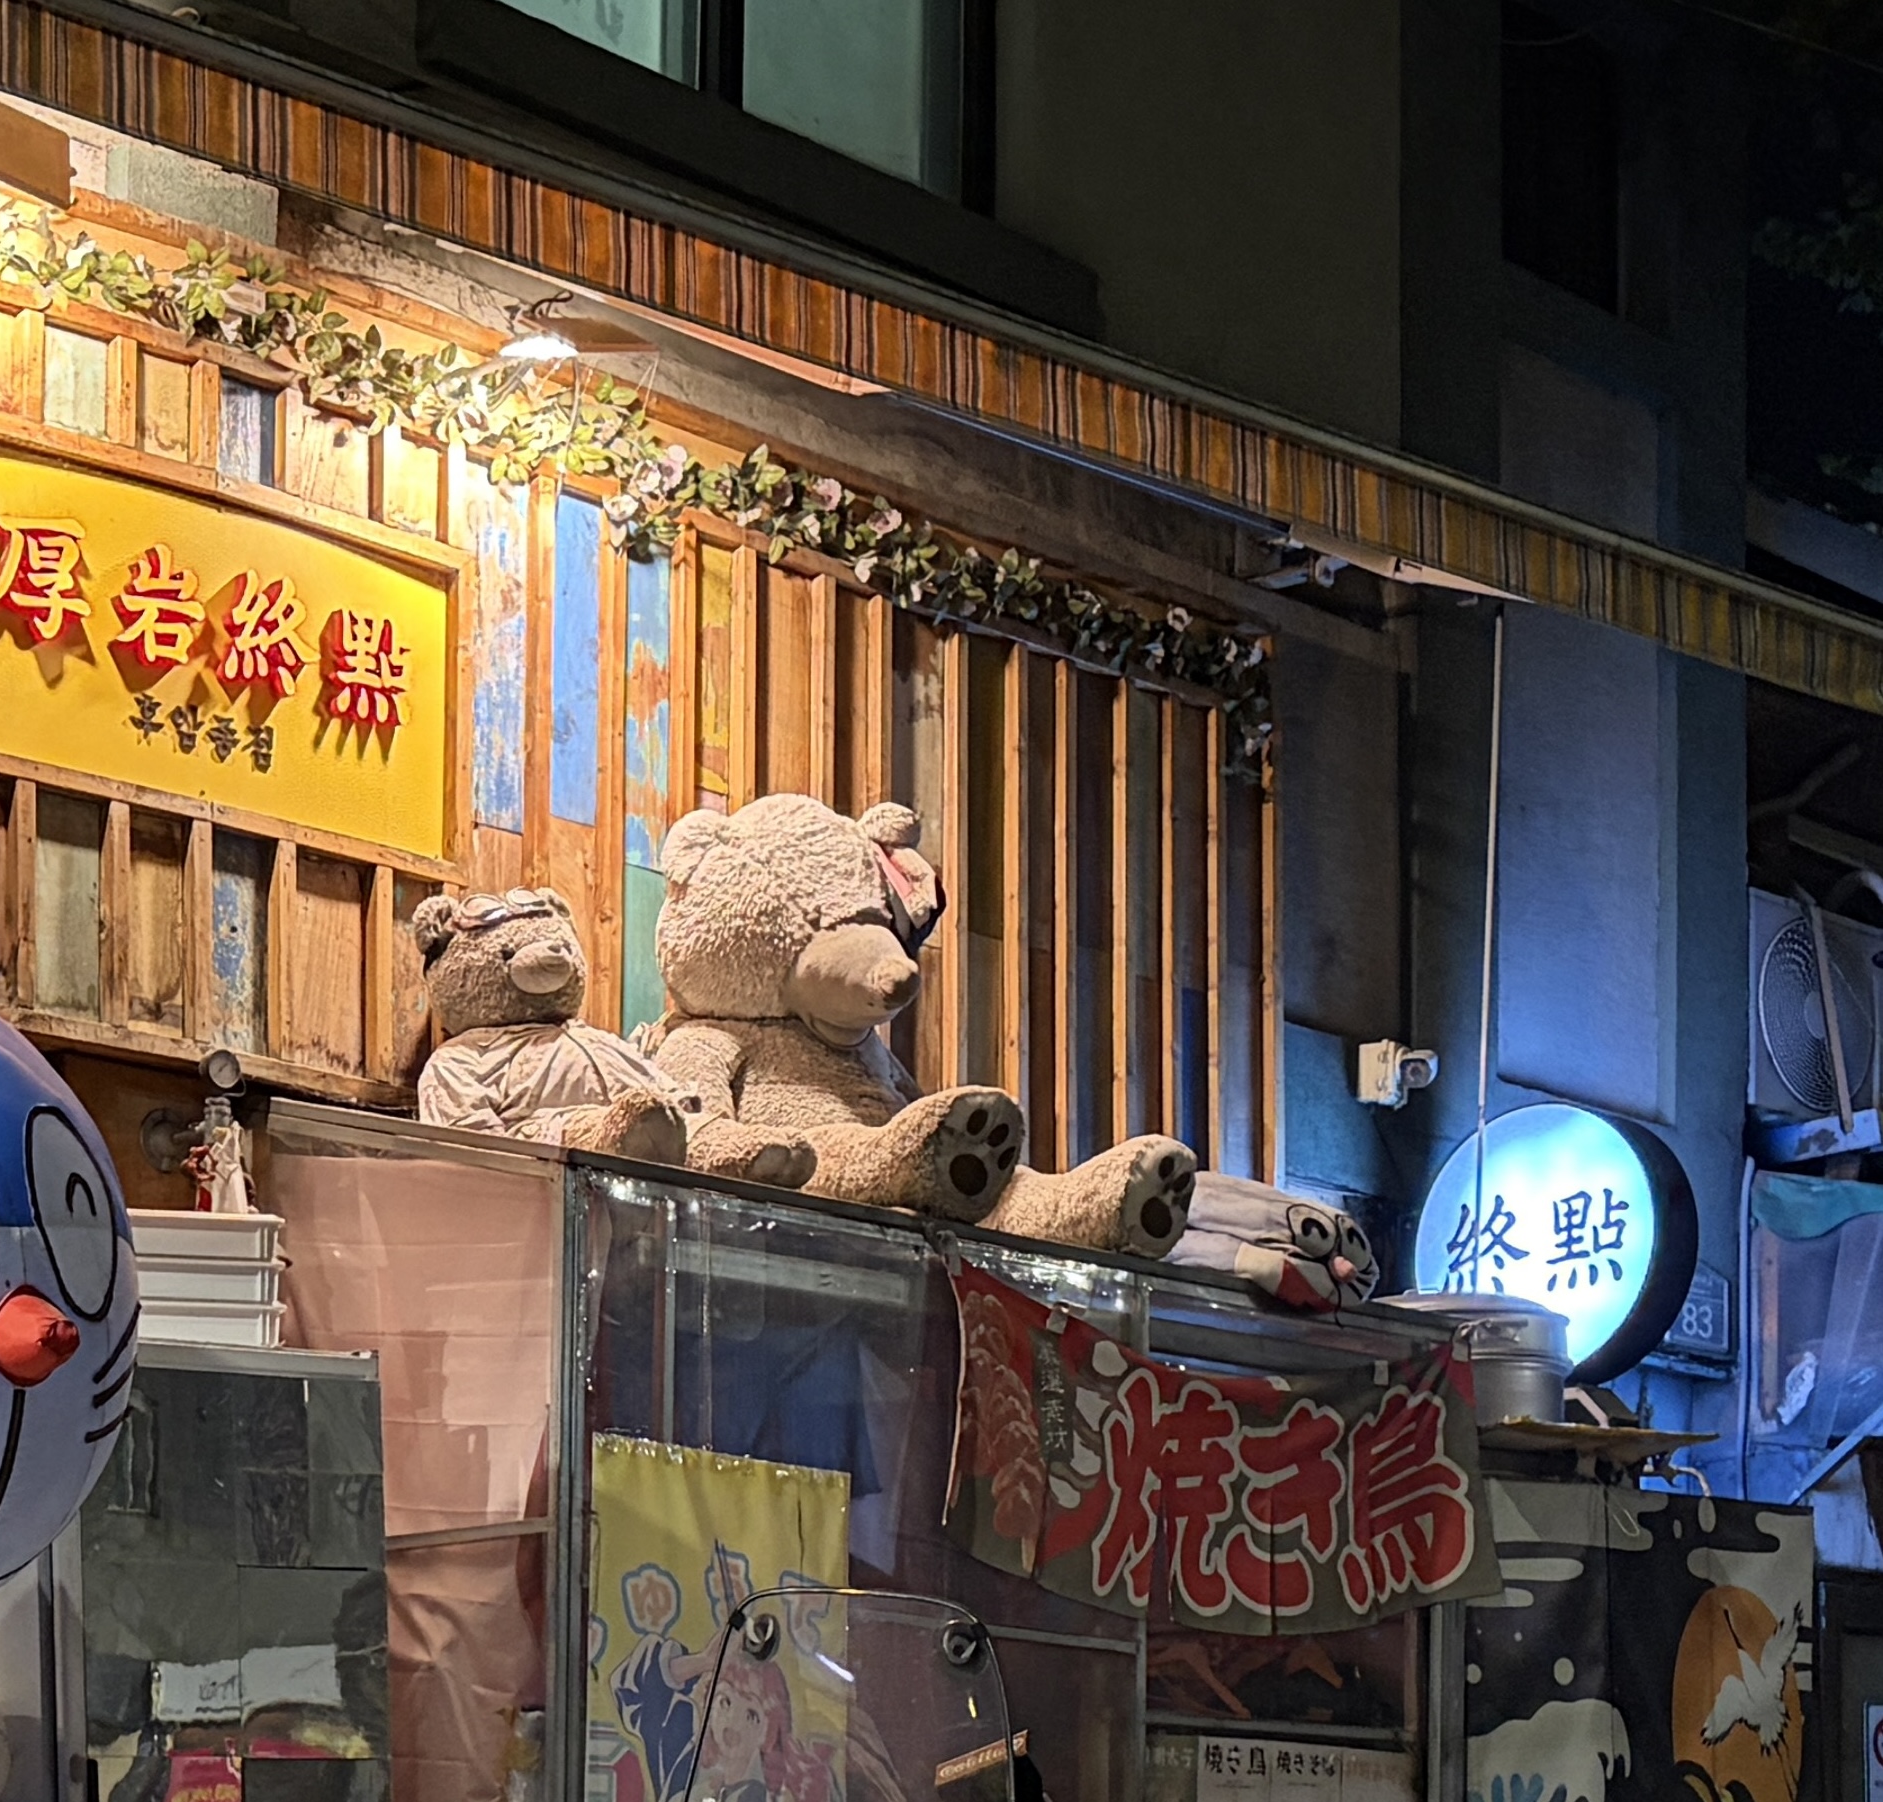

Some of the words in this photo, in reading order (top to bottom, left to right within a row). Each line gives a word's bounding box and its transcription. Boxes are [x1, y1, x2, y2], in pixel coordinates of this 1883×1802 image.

[129, 692, 274, 774] 후암종점
[1444, 1188, 1630, 1294] 終點
[1681, 1302, 1713, 1339] 83
[1093, 1368, 1475, 1616] 焼き鳥
